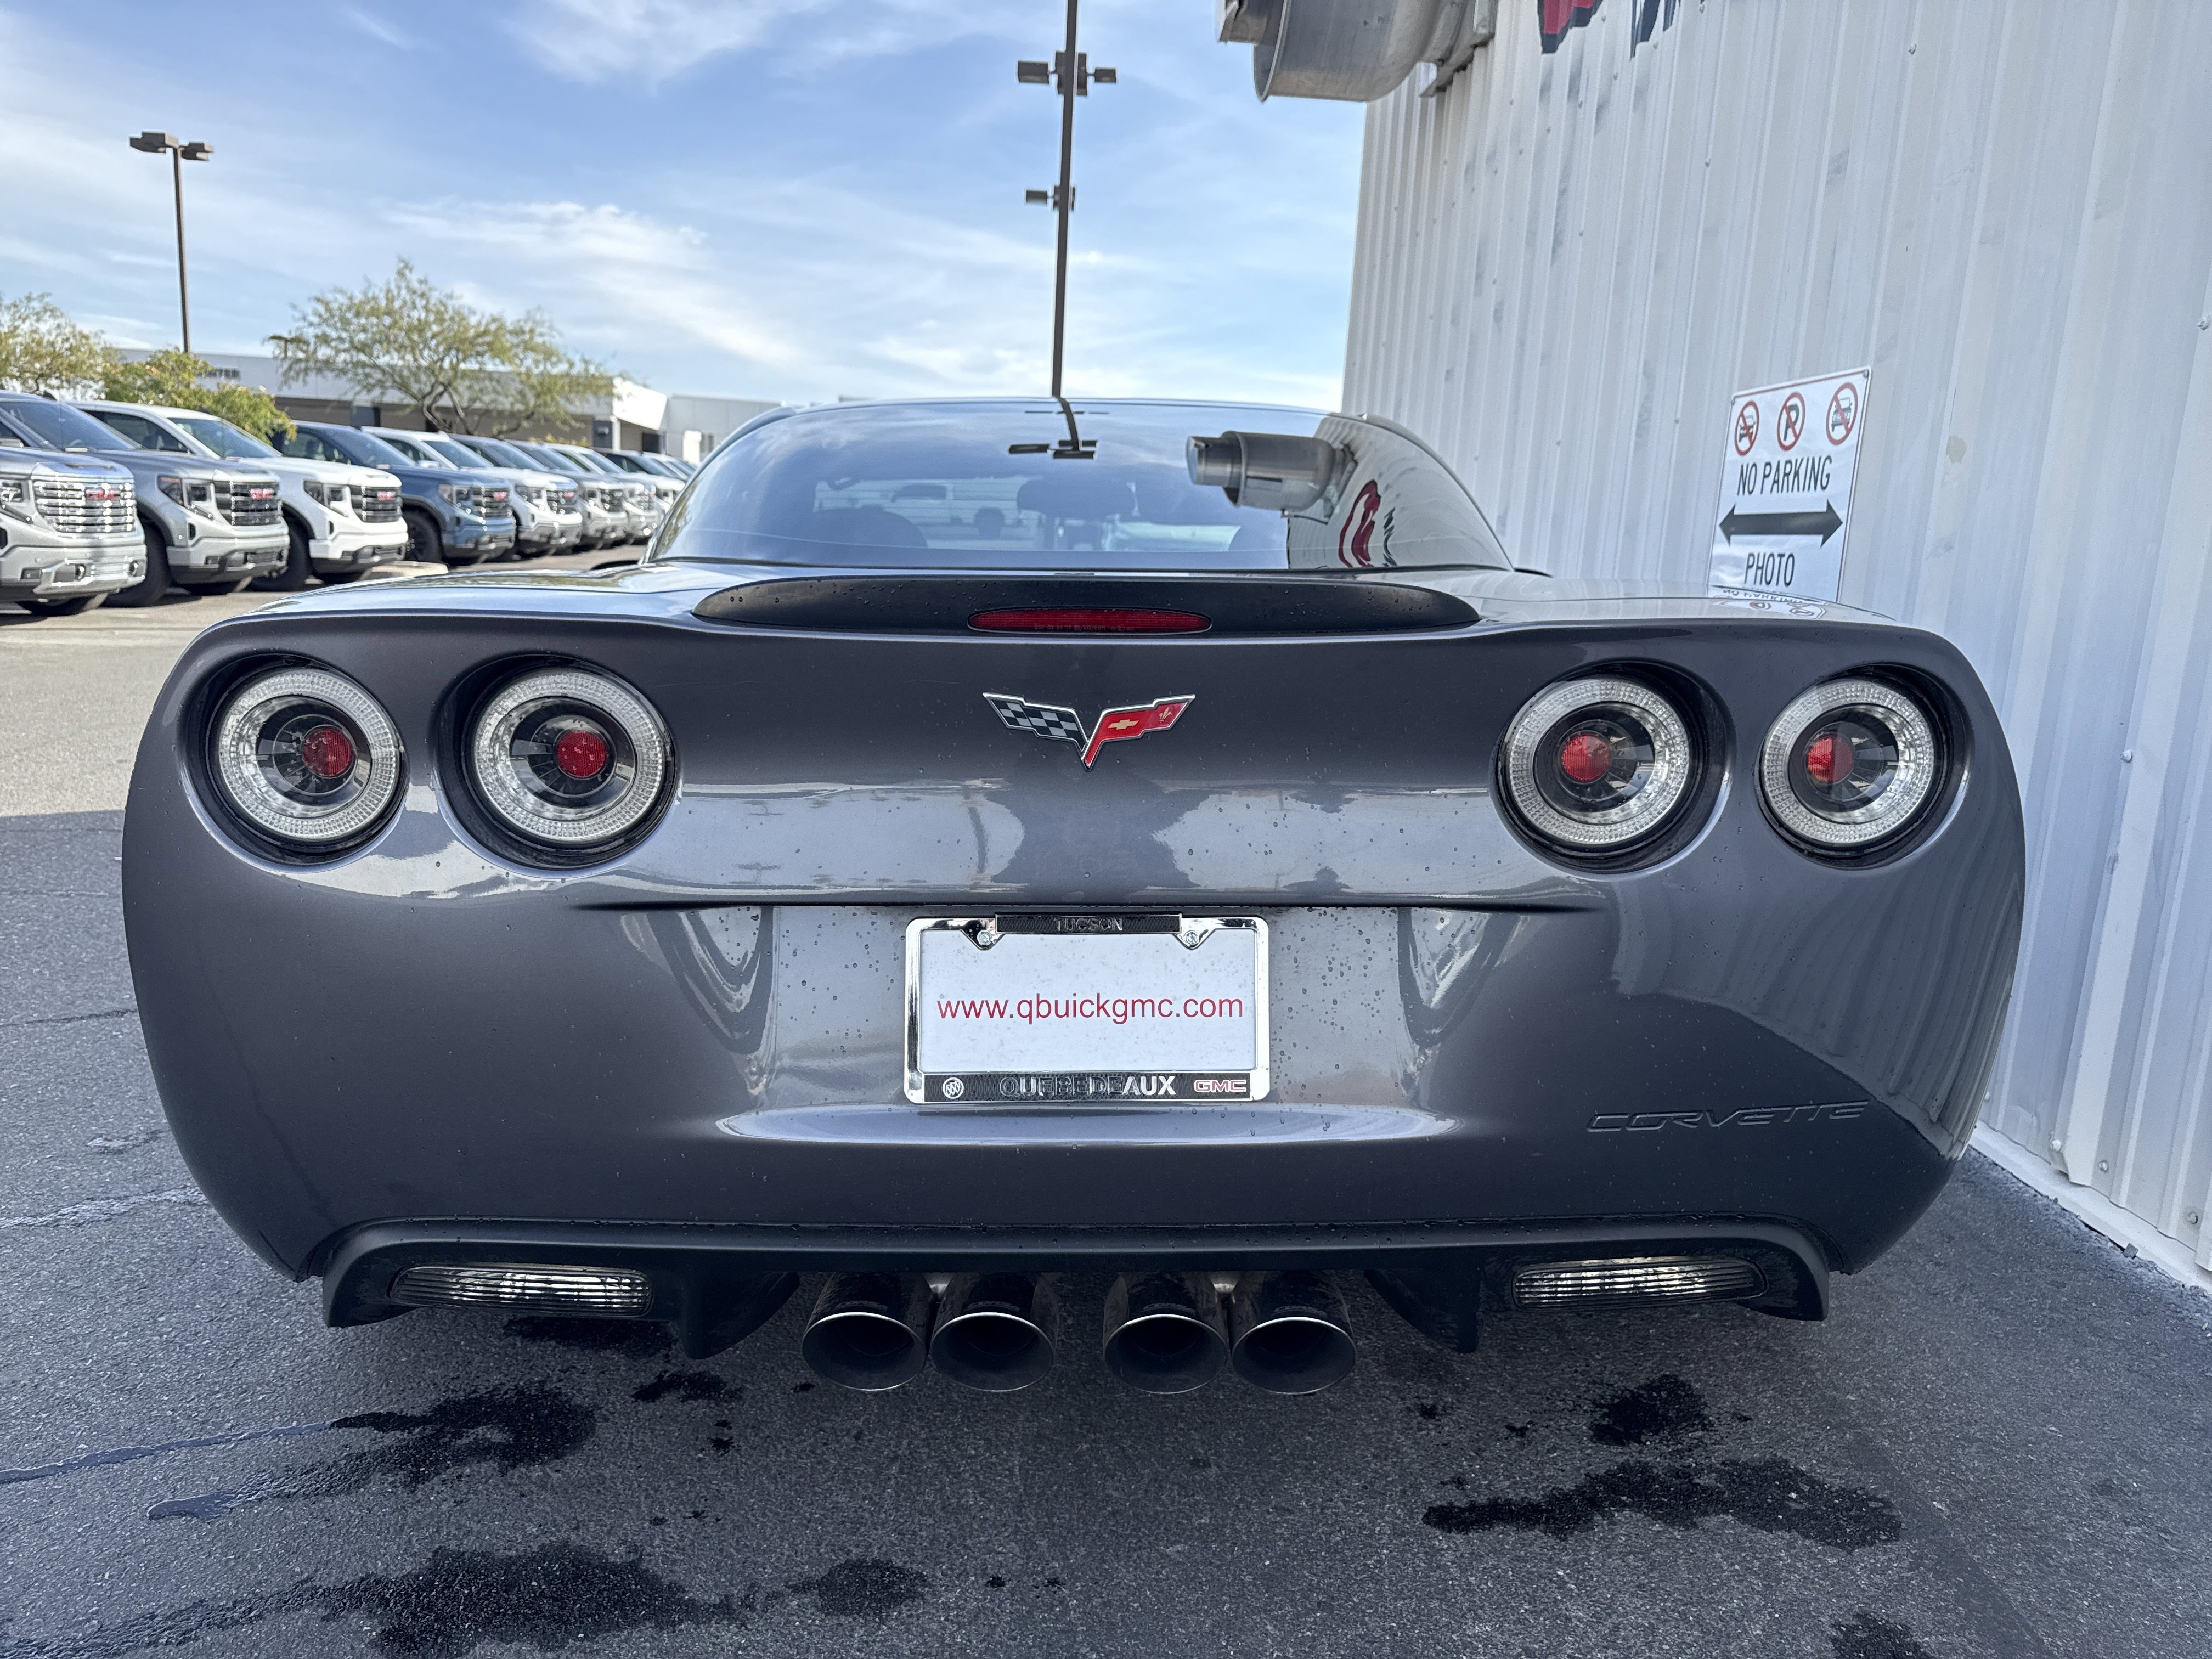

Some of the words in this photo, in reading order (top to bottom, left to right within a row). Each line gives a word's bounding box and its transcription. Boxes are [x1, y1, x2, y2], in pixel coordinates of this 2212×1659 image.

[1736, 461, 1757, 496] NO
[1760, 455, 1832, 494] PARKING
[1744, 552, 1796, 587] PHOTO
[1053, 918, 1123, 932] TUCSON
[937, 993, 1243, 1025] www.qbuickgmc.com
[999, 1075, 1176, 1097] QUEBEDEAUX
[1194, 1079, 1247, 1093] GMC
[1586, 1099, 1869, 1132] CORVETTE
